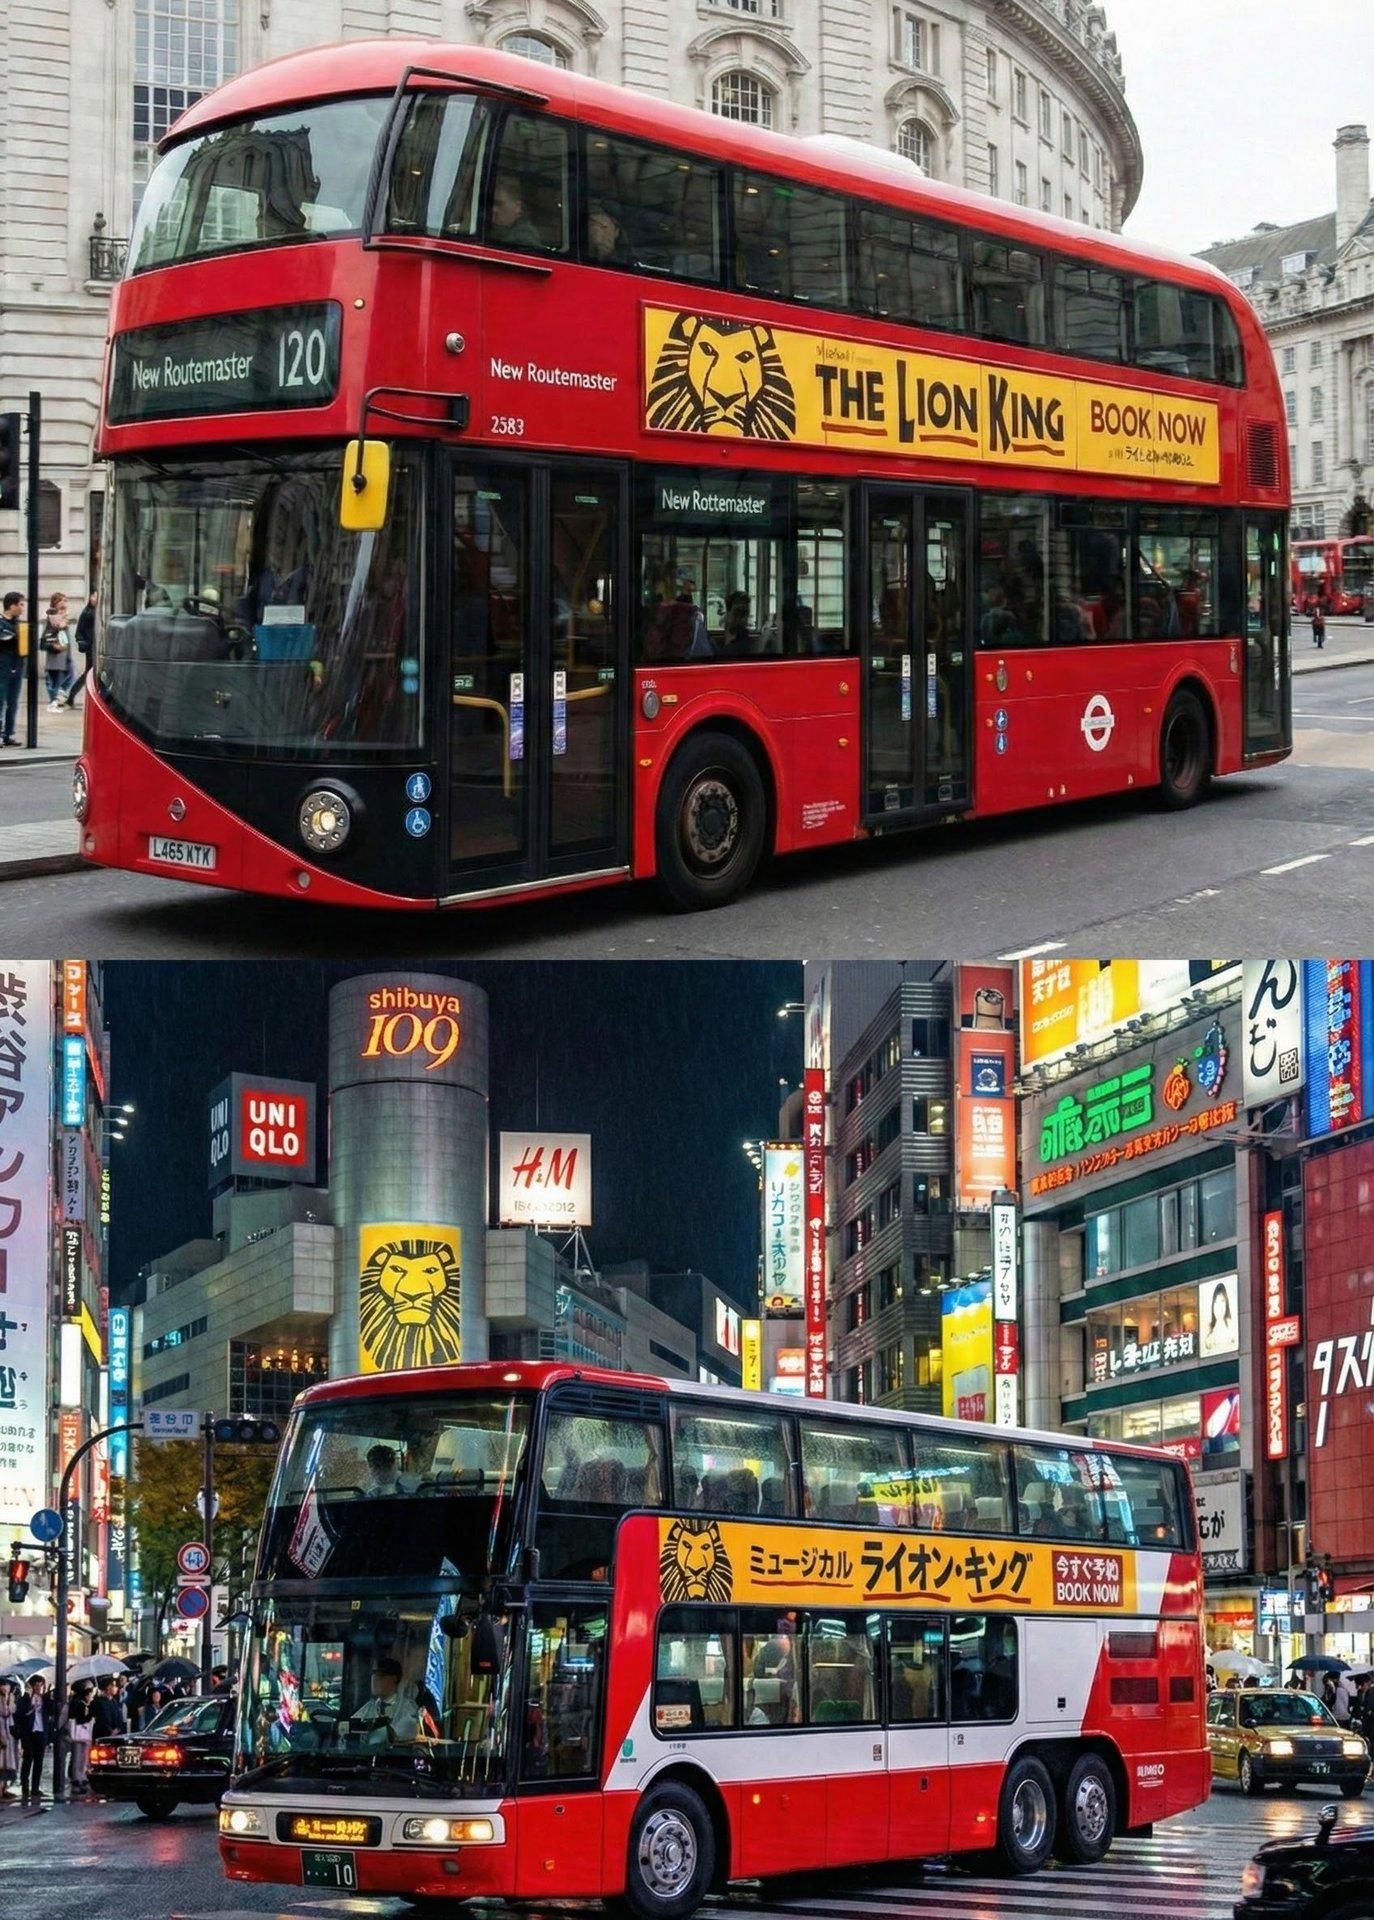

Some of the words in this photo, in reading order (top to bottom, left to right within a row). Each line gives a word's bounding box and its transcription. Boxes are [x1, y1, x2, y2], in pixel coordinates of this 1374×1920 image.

[132, 359, 161, 392] New
[164, 350, 254, 387] Routemaster
[278, 328, 327, 388] 120
[490, 356, 524, 381] New
[527, 361, 618, 392] Routemaster
[815, 363, 885, 423] THE
[490, 415, 525, 436] 2583
[1091, 398, 1152, 440] BOOK
[1158, 409, 1207, 447] NOW
[661, 487, 691, 511] New
[153, 838, 184, 861] L465
[368, 986, 461, 1016] shibuya
[360, 1011, 461, 1071] 109
[210, 1097, 229, 1134] UNI
[248, 1099, 297, 1129] UNI
[210, 1129, 230, 1168] QLO
[248, 1126, 301, 1158] QLO
[750, 1544, 854, 1580] ミュージカル
[861, 1540, 1033, 1594] ライオン・キング
[1056, 1582, 1092, 1602] BOOK
[1093, 1583, 1120, 1603] NOW
